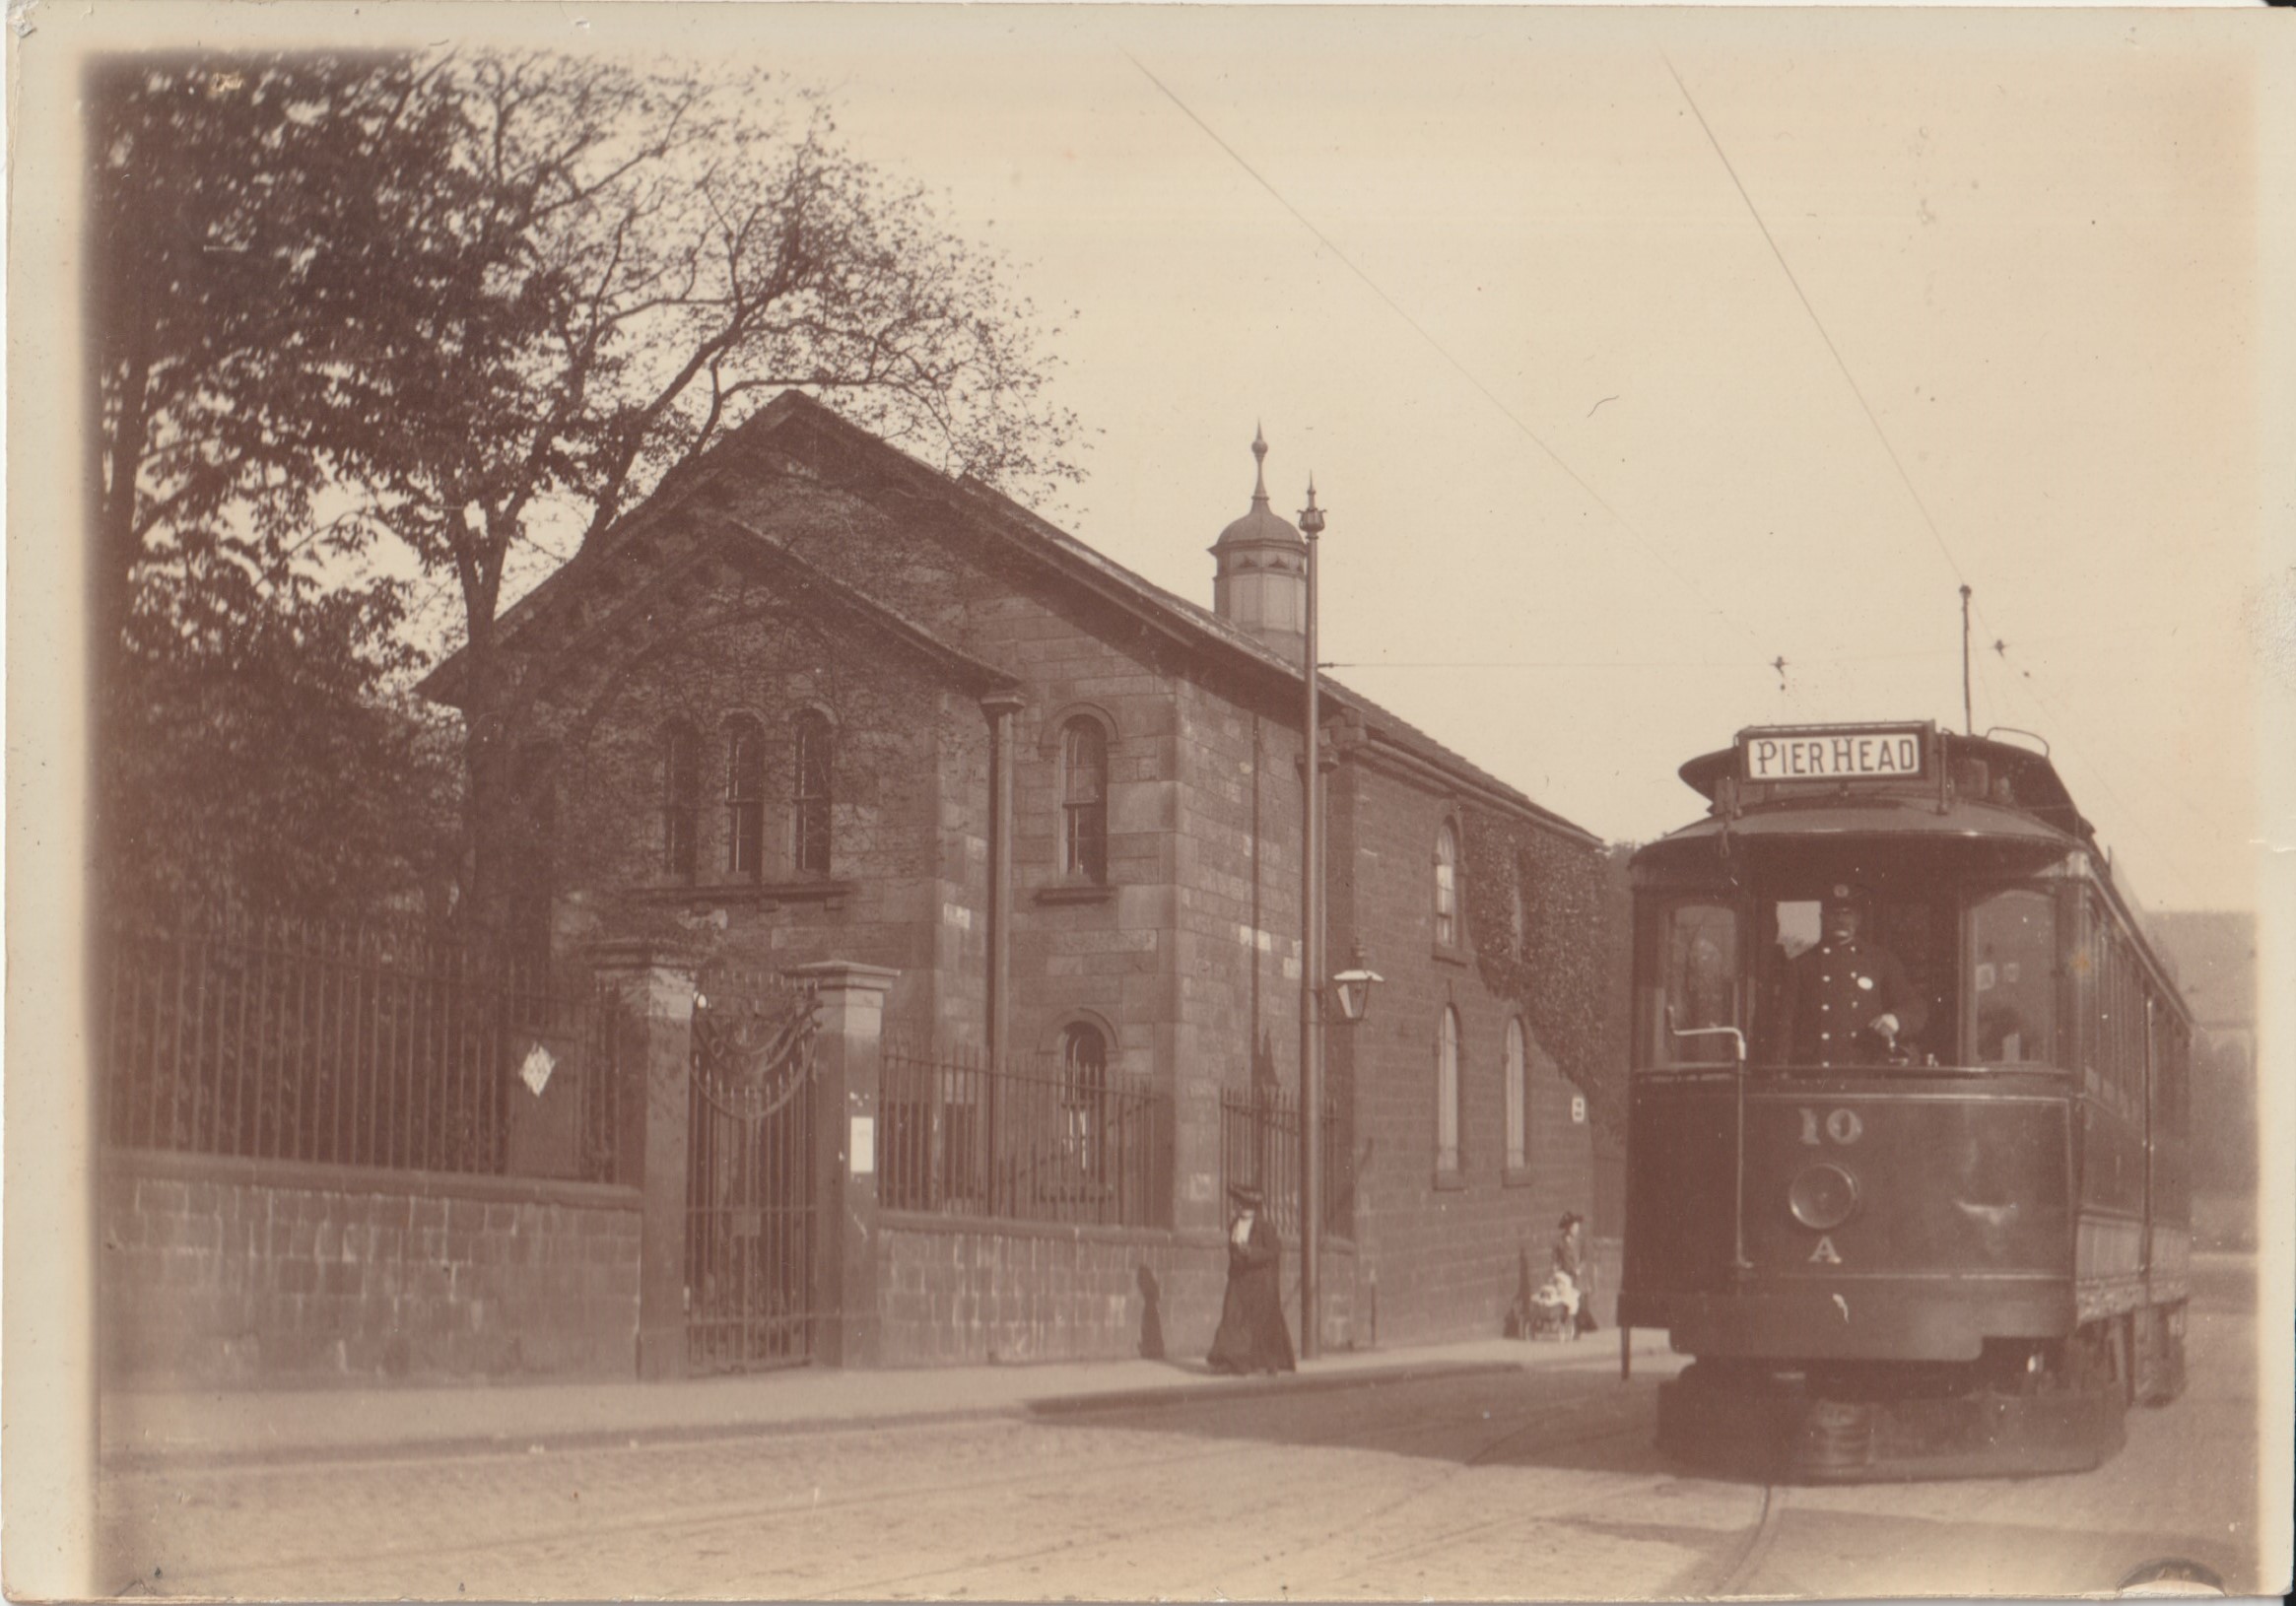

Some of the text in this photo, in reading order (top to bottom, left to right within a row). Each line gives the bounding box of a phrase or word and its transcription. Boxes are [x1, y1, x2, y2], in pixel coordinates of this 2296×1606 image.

[1757, 737, 1915, 774] PIER HEAD
[1798, 1107, 1863, 1146] 10
[1808, 1235, 1842, 1263] A
